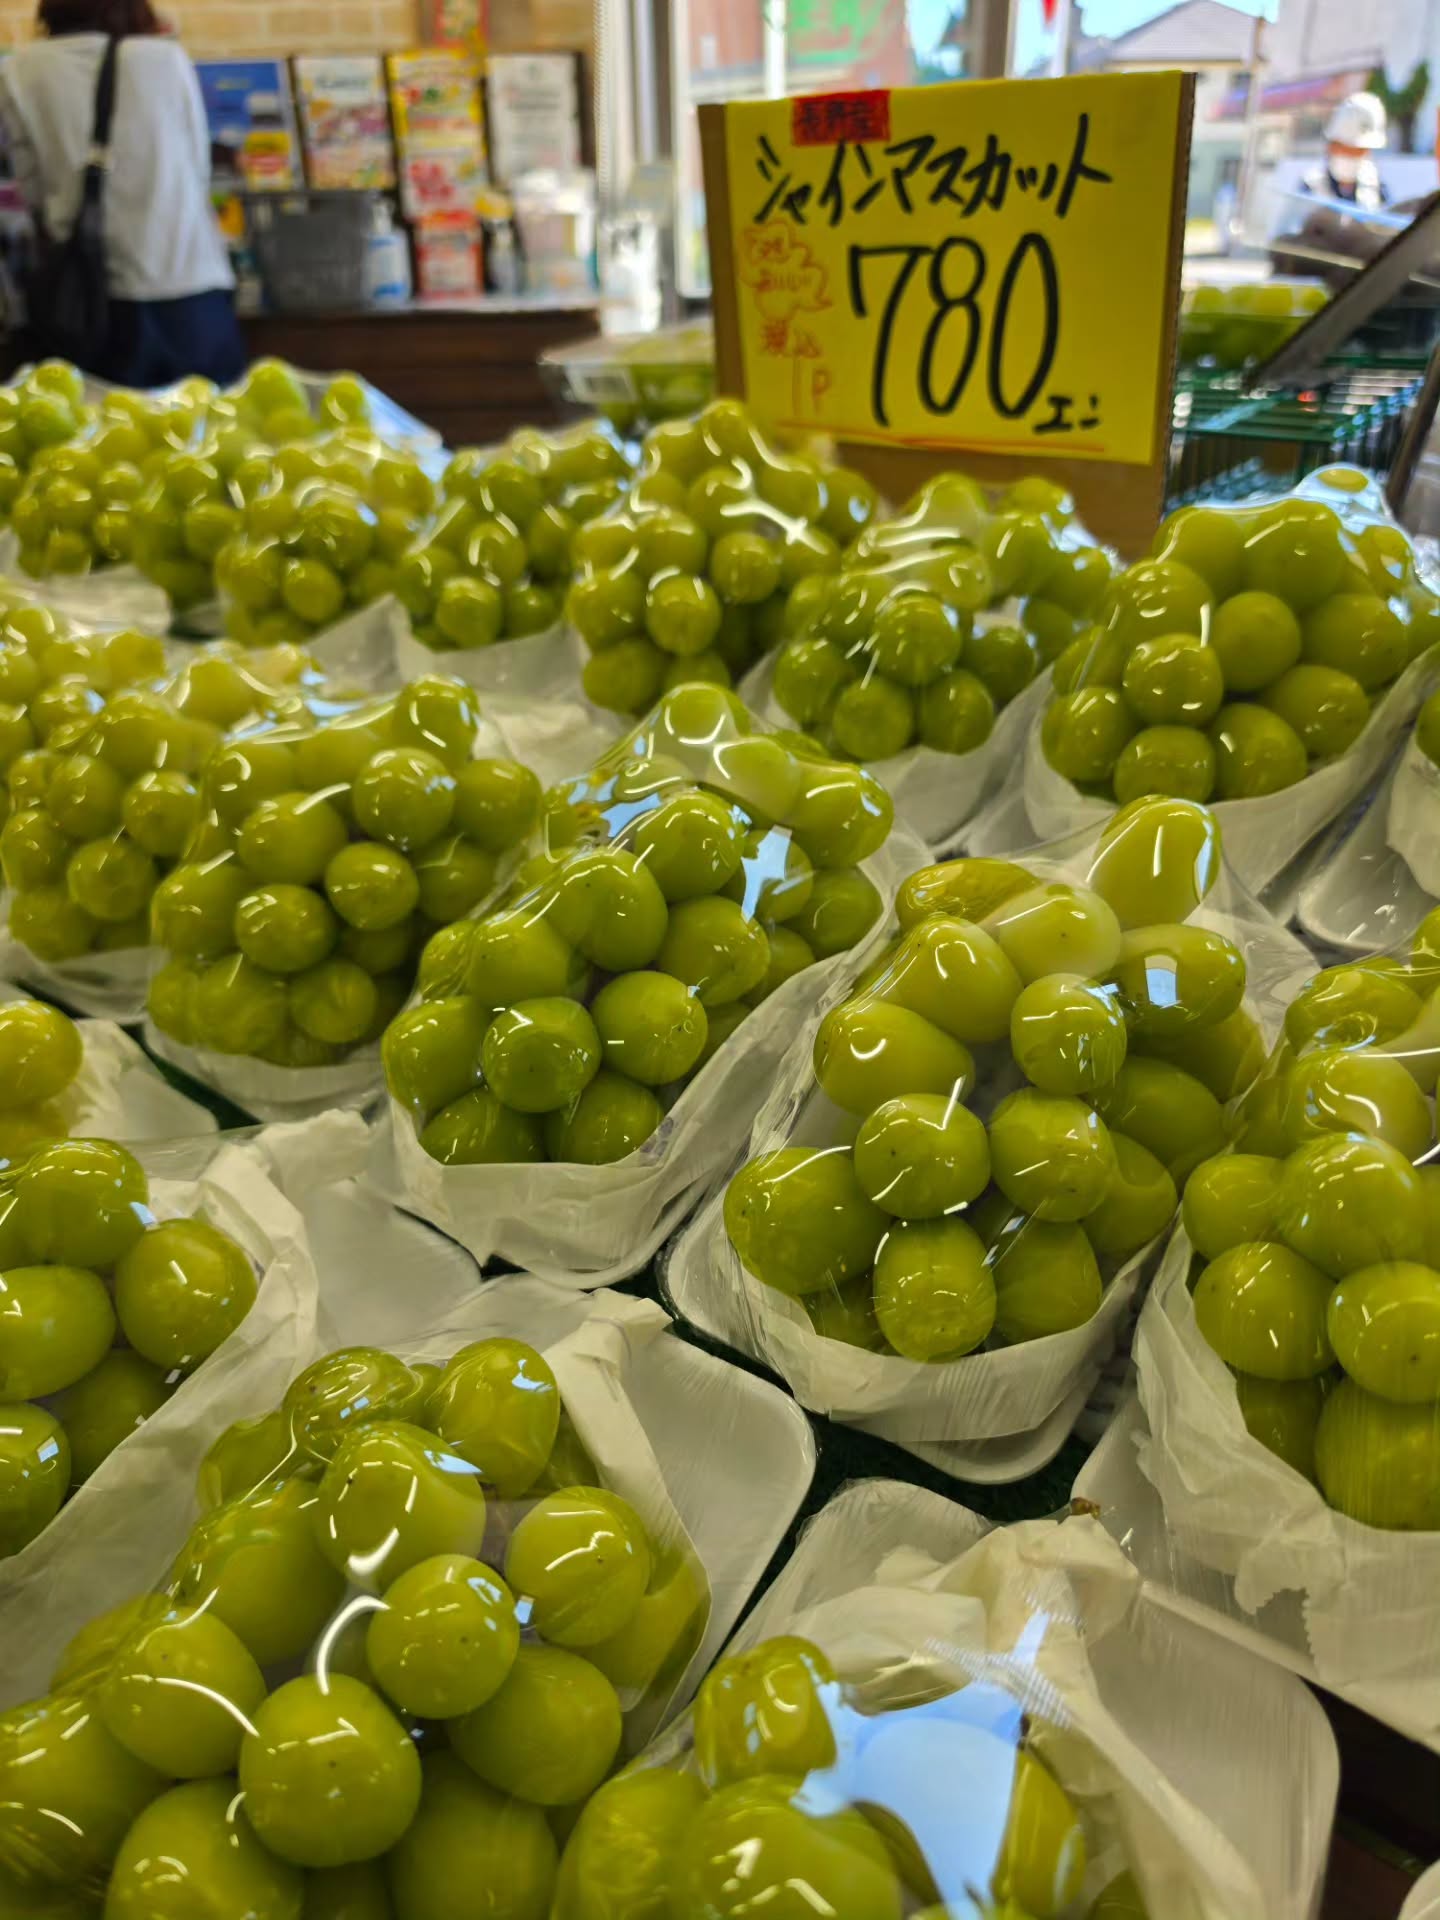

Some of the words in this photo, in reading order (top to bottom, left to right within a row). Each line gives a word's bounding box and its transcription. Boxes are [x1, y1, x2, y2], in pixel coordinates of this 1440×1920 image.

[754, 113, 1113, 227] シャインマスカット
[848, 233, 1061, 428] 780
